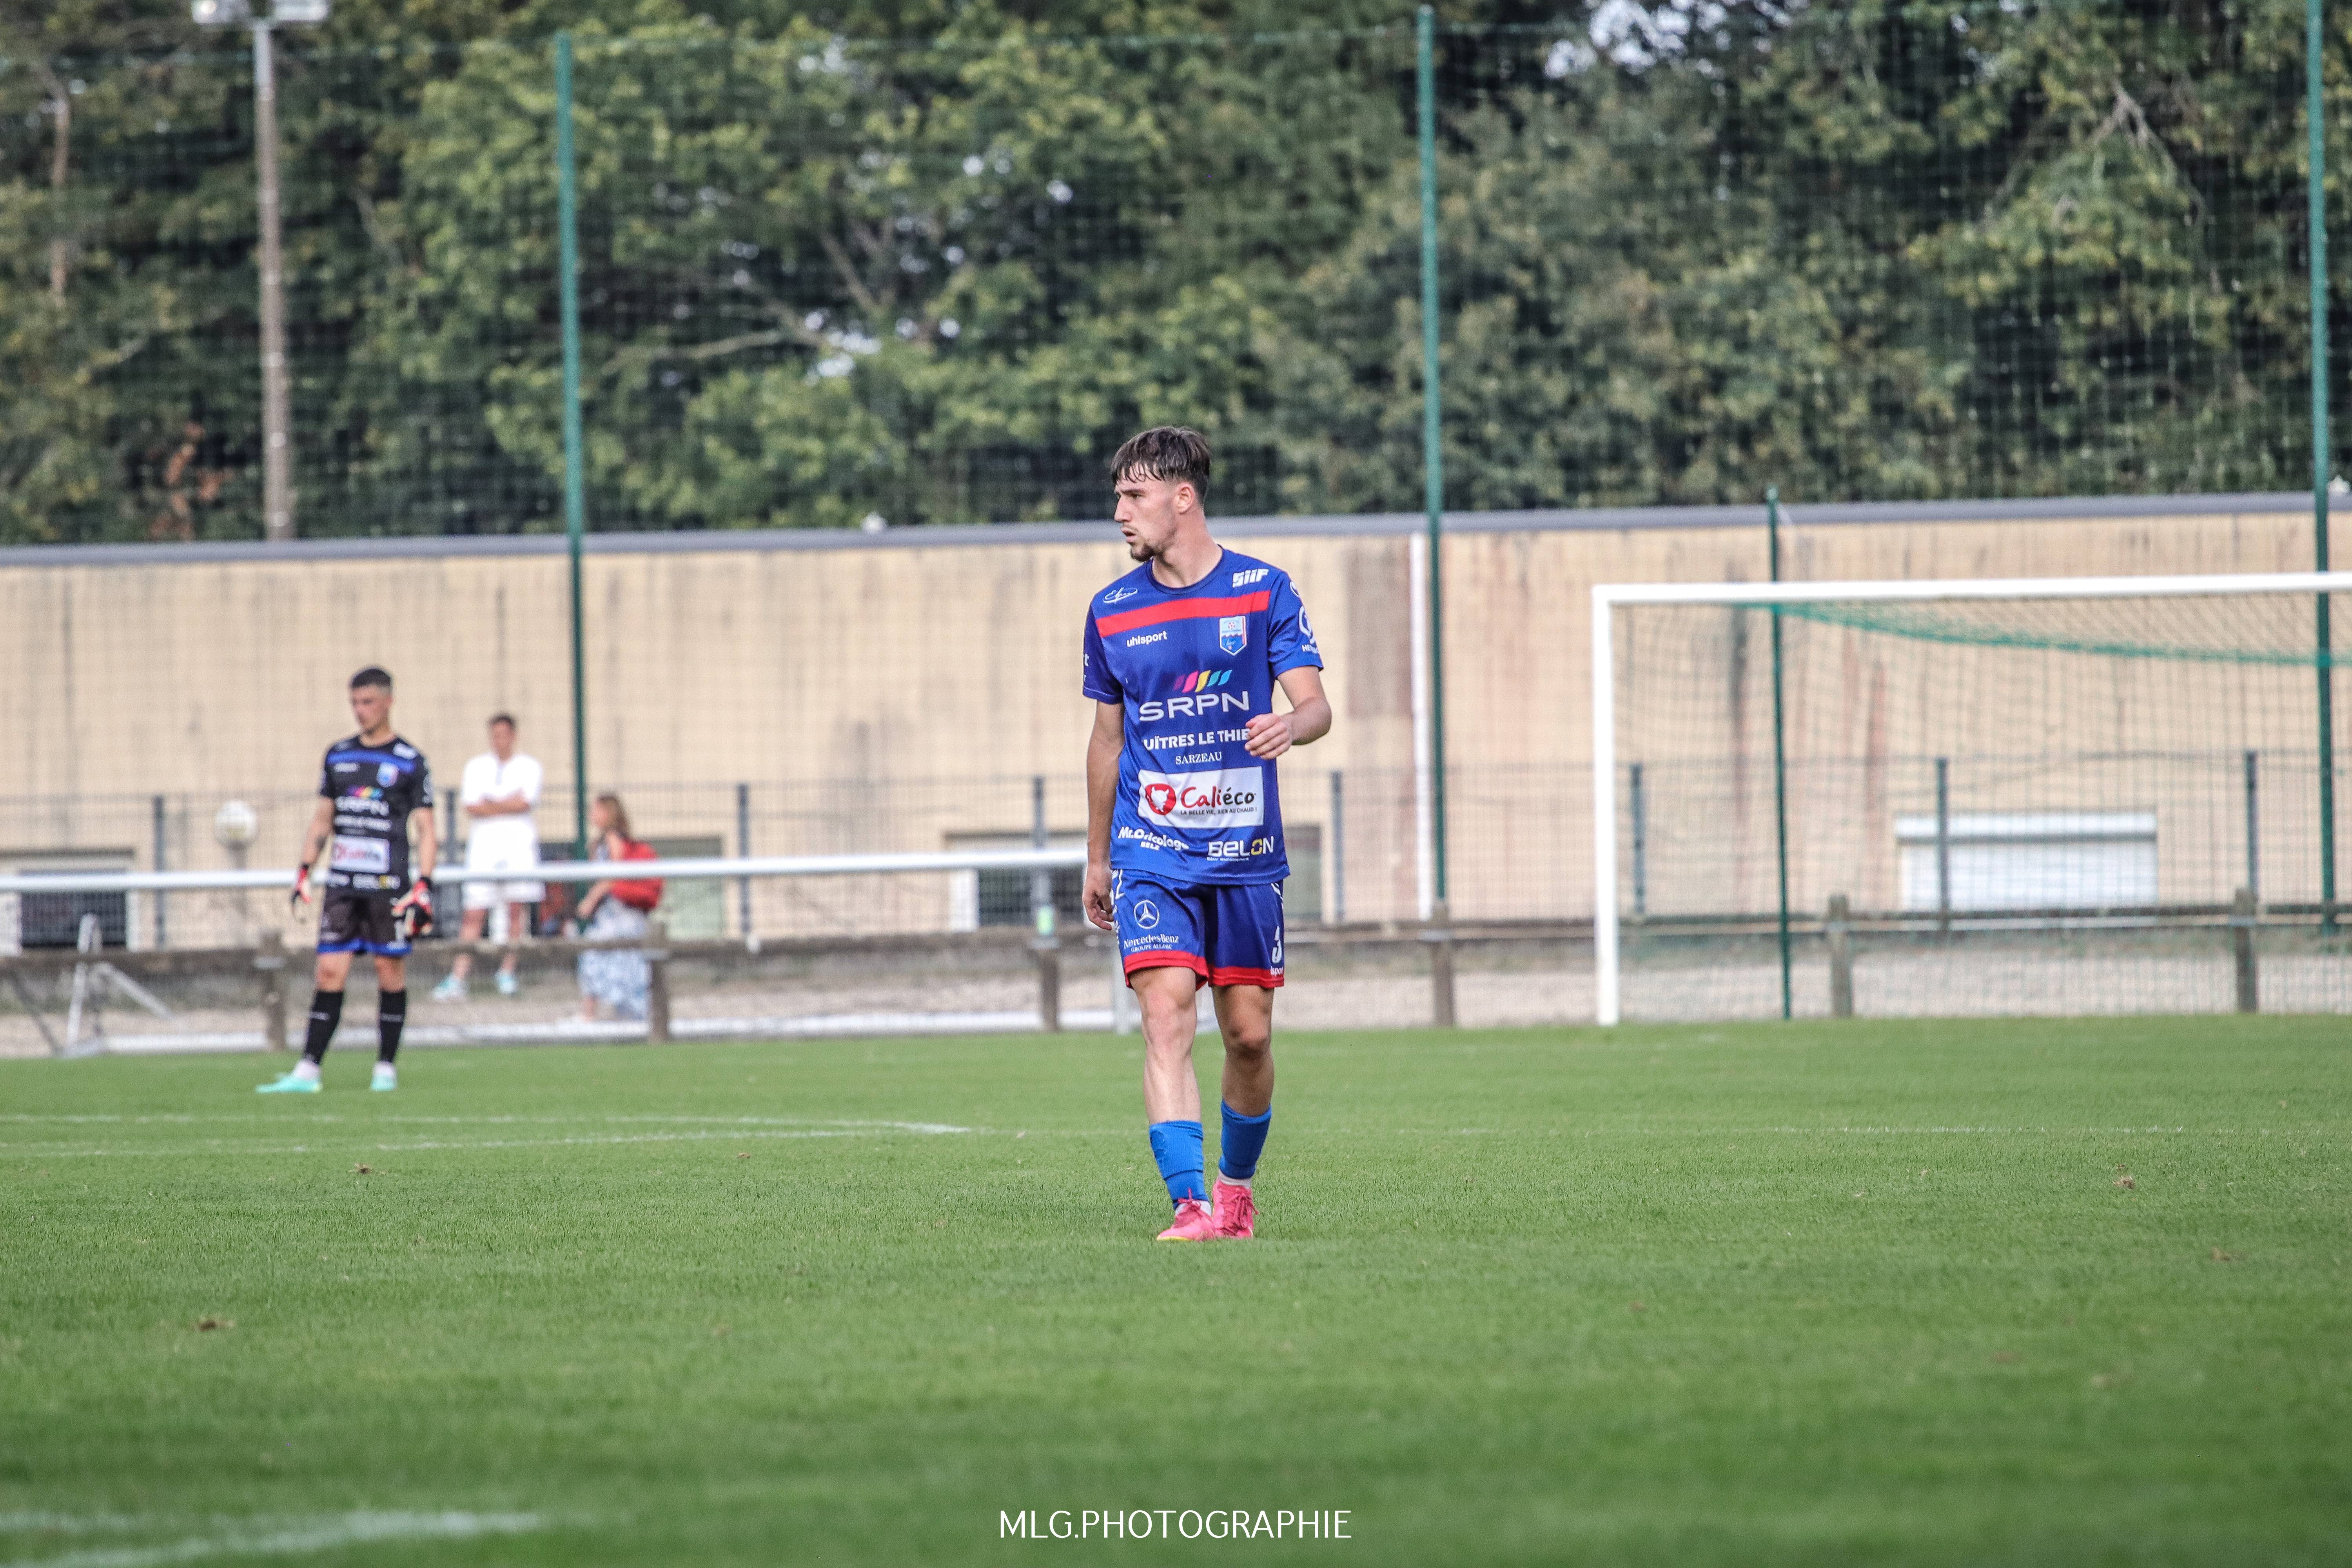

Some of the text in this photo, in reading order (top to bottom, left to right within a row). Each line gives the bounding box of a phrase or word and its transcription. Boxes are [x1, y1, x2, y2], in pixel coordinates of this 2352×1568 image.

[1126, 630, 1168, 648] uhlsport
[1139, 691, 1250, 722] SRPN
[1142, 728, 1250, 751] UÏTRES LE THIE
[1175, 751, 1222, 764] SARZEAU
[1181, 786, 1254, 808] Caliéco
